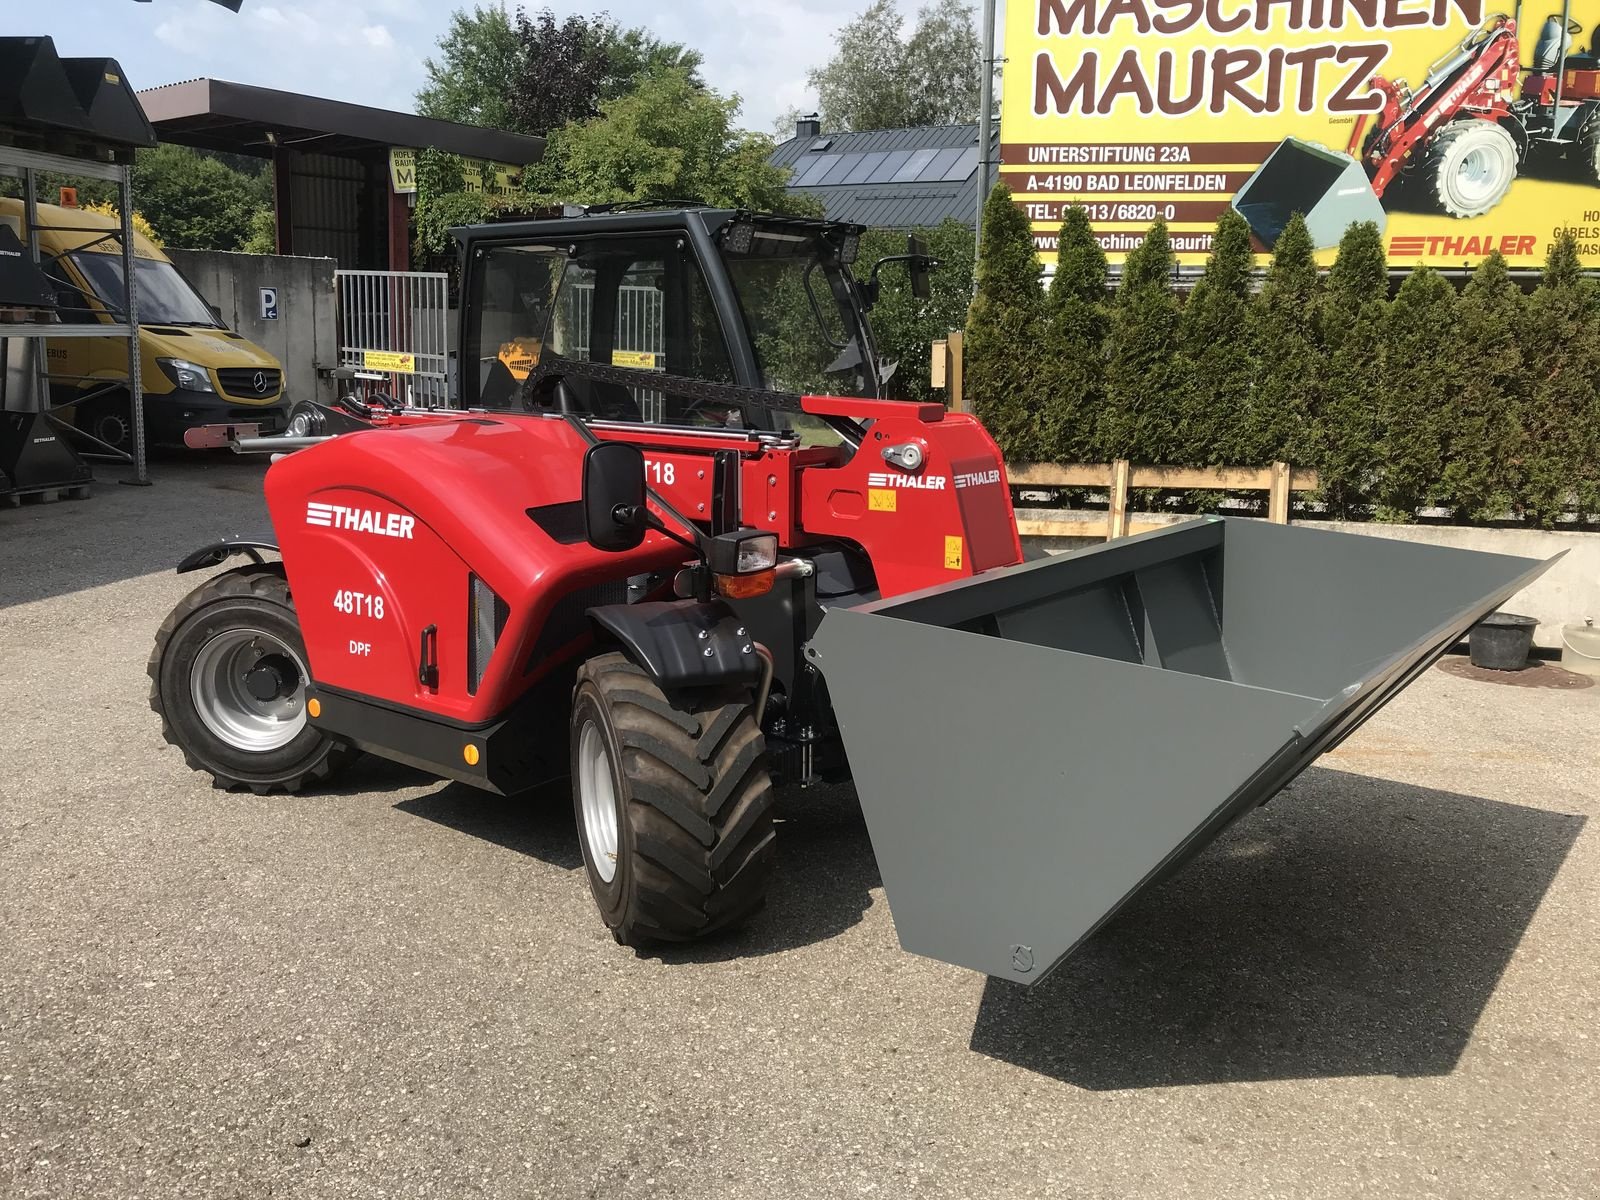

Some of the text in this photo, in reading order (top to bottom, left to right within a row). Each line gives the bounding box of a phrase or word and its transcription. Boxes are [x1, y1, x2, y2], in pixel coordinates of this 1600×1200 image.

[1034, 44, 1388, 115] MAURITZ
[1028, 146, 1191, 163] UNTERSTIFTUNG 23A
[1027, 174, 1227, 191] A-4190 BAD LEONFELDEN
[1026, 204, 1057, 220] TEL:
[1426, 235, 1537, 256] THALER
[261, 289, 276, 318] P
[887, 474, 946, 490] THALER
[966, 470, 1000, 487] THALER
[332, 505, 415, 539] THALER
[334, 590, 384, 619] 48T18
[349, 640, 371, 657] DPF
